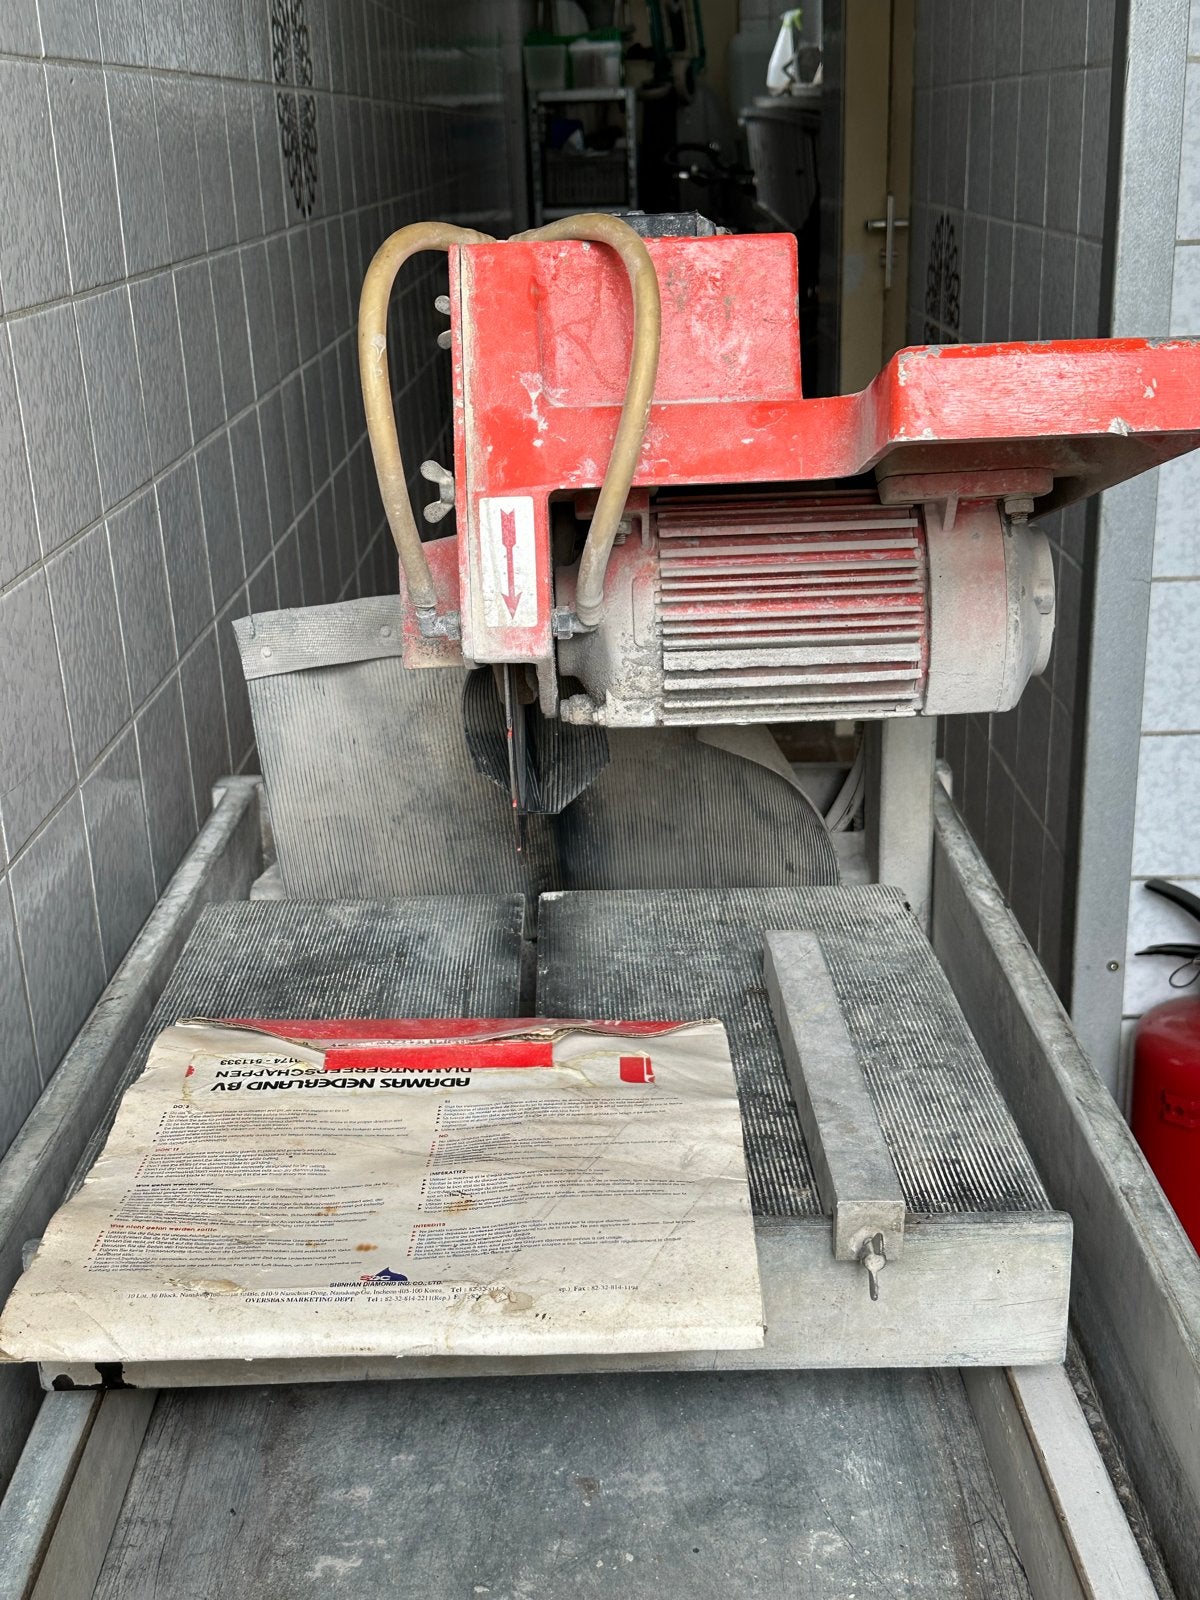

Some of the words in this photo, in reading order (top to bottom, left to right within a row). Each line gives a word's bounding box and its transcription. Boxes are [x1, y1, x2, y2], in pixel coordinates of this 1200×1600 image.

[210, 1080, 242, 1092] BV
[246, 1077, 375, 1092] NEDERLAND
[380, 1077, 471, 1089] ADAMAS
[286, 1295, 333, 1303] MARKETING
